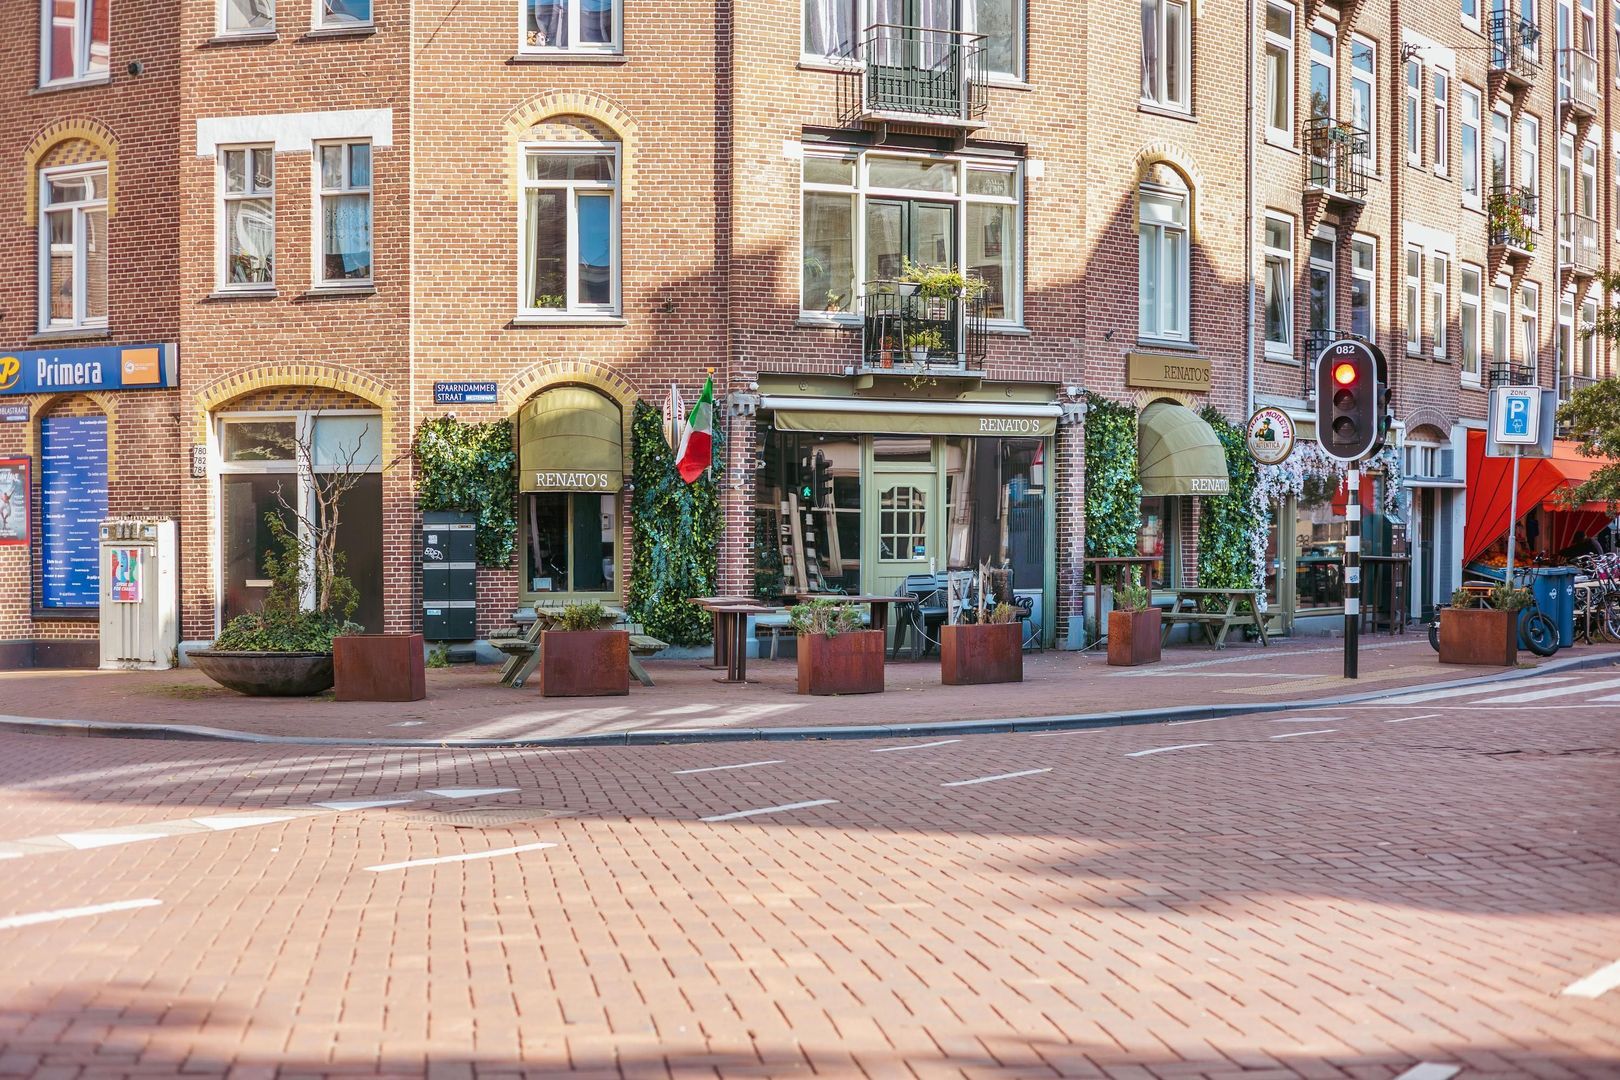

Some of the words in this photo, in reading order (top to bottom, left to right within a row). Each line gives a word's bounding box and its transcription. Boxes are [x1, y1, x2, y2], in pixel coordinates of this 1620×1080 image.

[1336, 345, 1355, 354] 082
[37, 357, 103, 386] Primera
[1164, 365, 1210, 382] RENATO'S
[437, 384, 496, 392] SPAARNDAMMER
[437, 393, 463, 401] STRAAT
[1510, 400, 1525, 419] P
[979, 418, 1040, 432] RENATO'S
[1264, 411, 1290, 439] MORETTI
[194, 447, 207, 455] 780
[194, 456, 207, 465] 782
[194, 466, 207, 474] 784
[536, 472, 608, 488] RENATO'S
